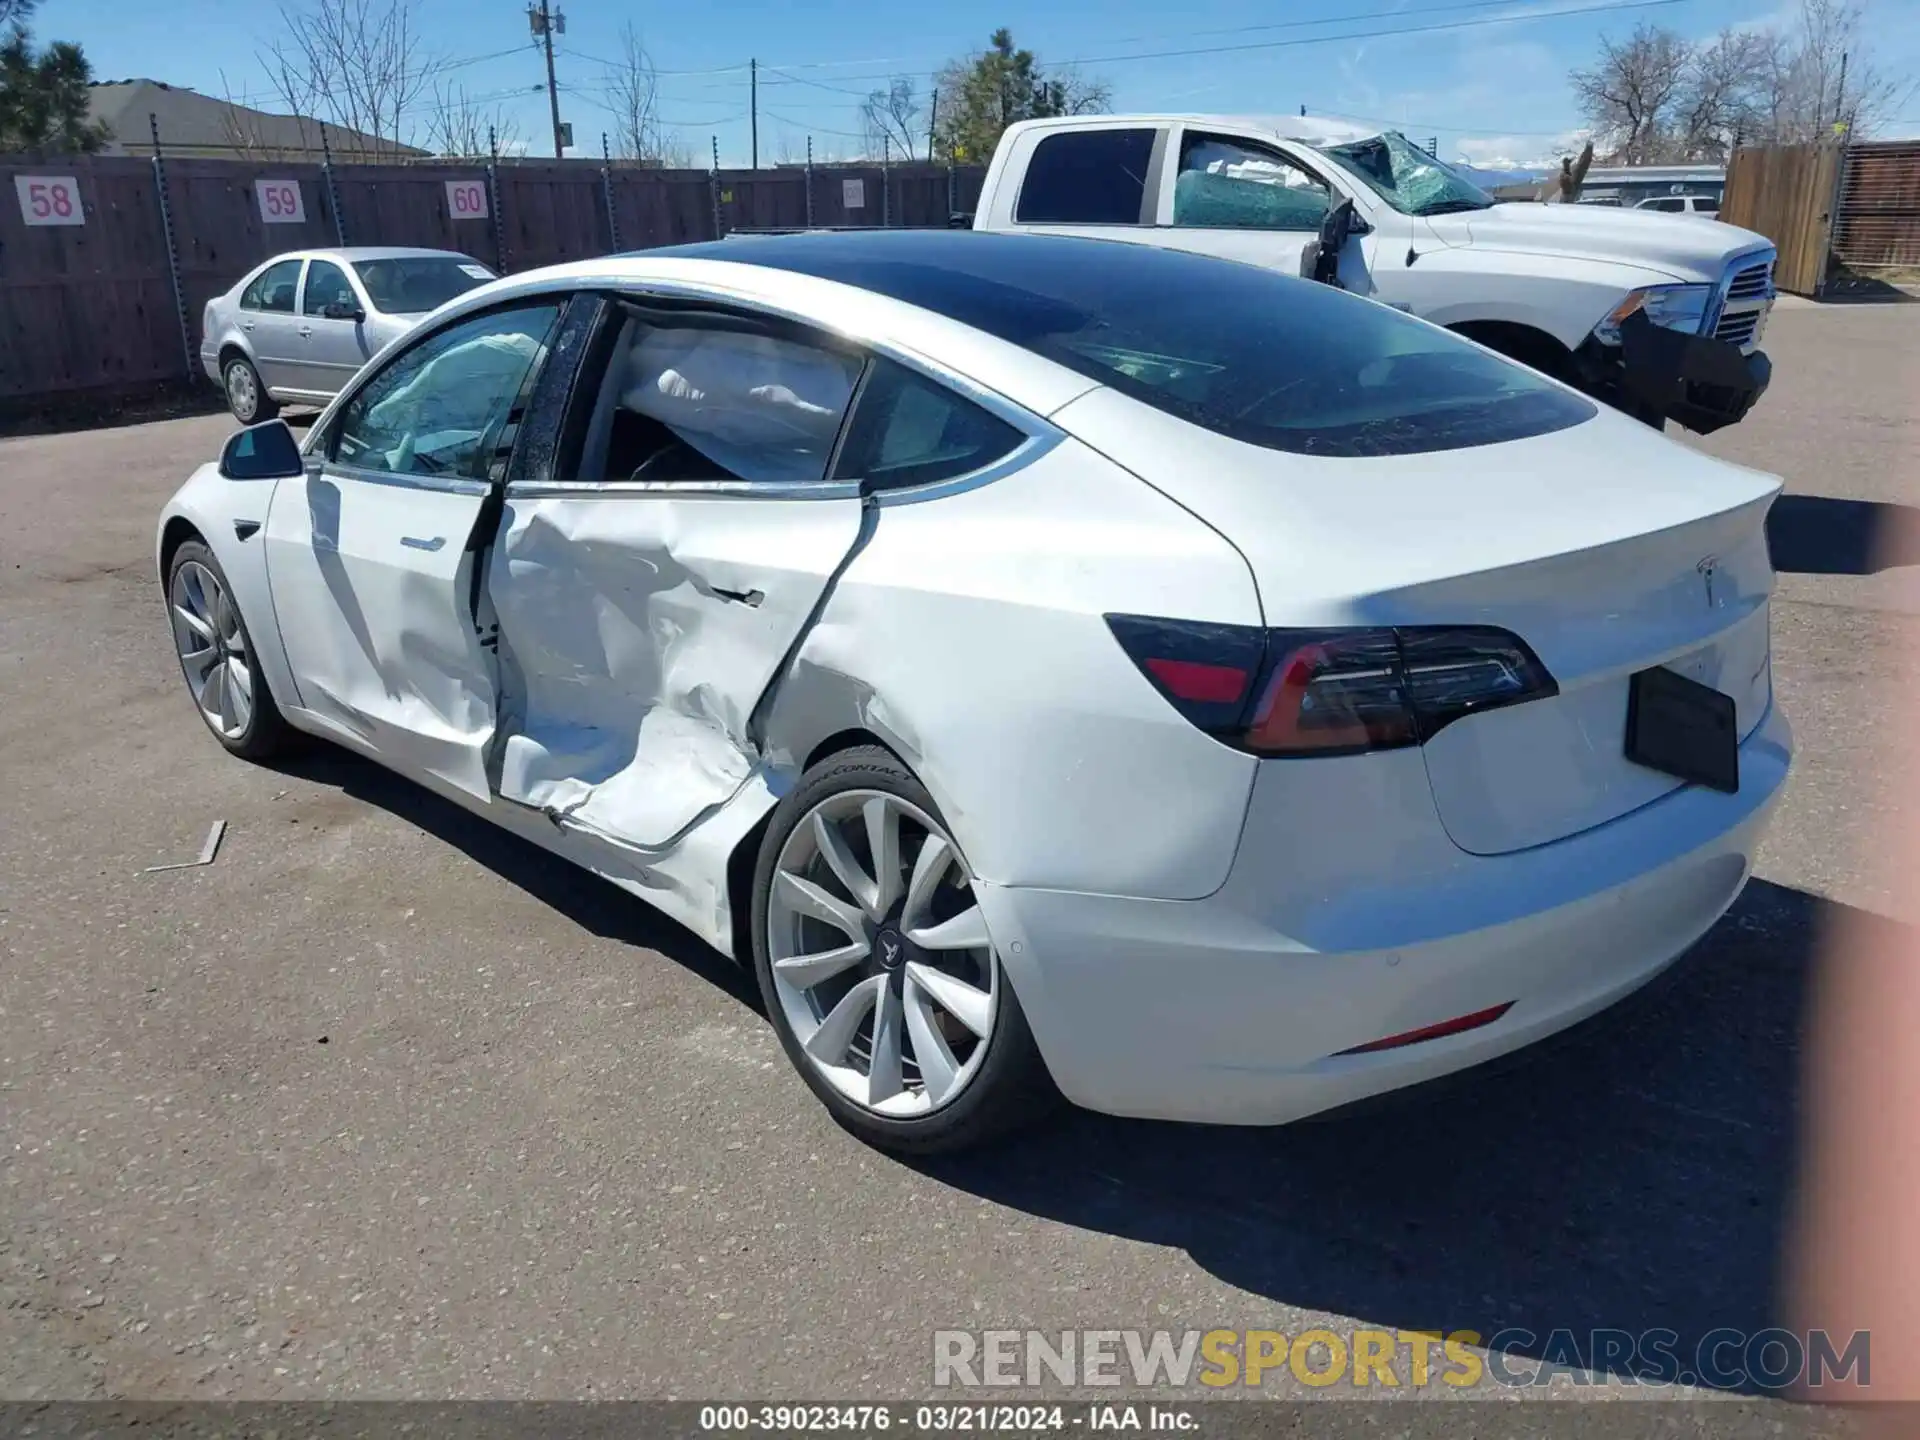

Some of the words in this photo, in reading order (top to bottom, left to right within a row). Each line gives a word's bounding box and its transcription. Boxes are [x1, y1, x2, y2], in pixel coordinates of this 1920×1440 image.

[30, 184, 73, 217] 58
[265, 187, 296, 215] 59
[454, 187, 481, 212] 60
